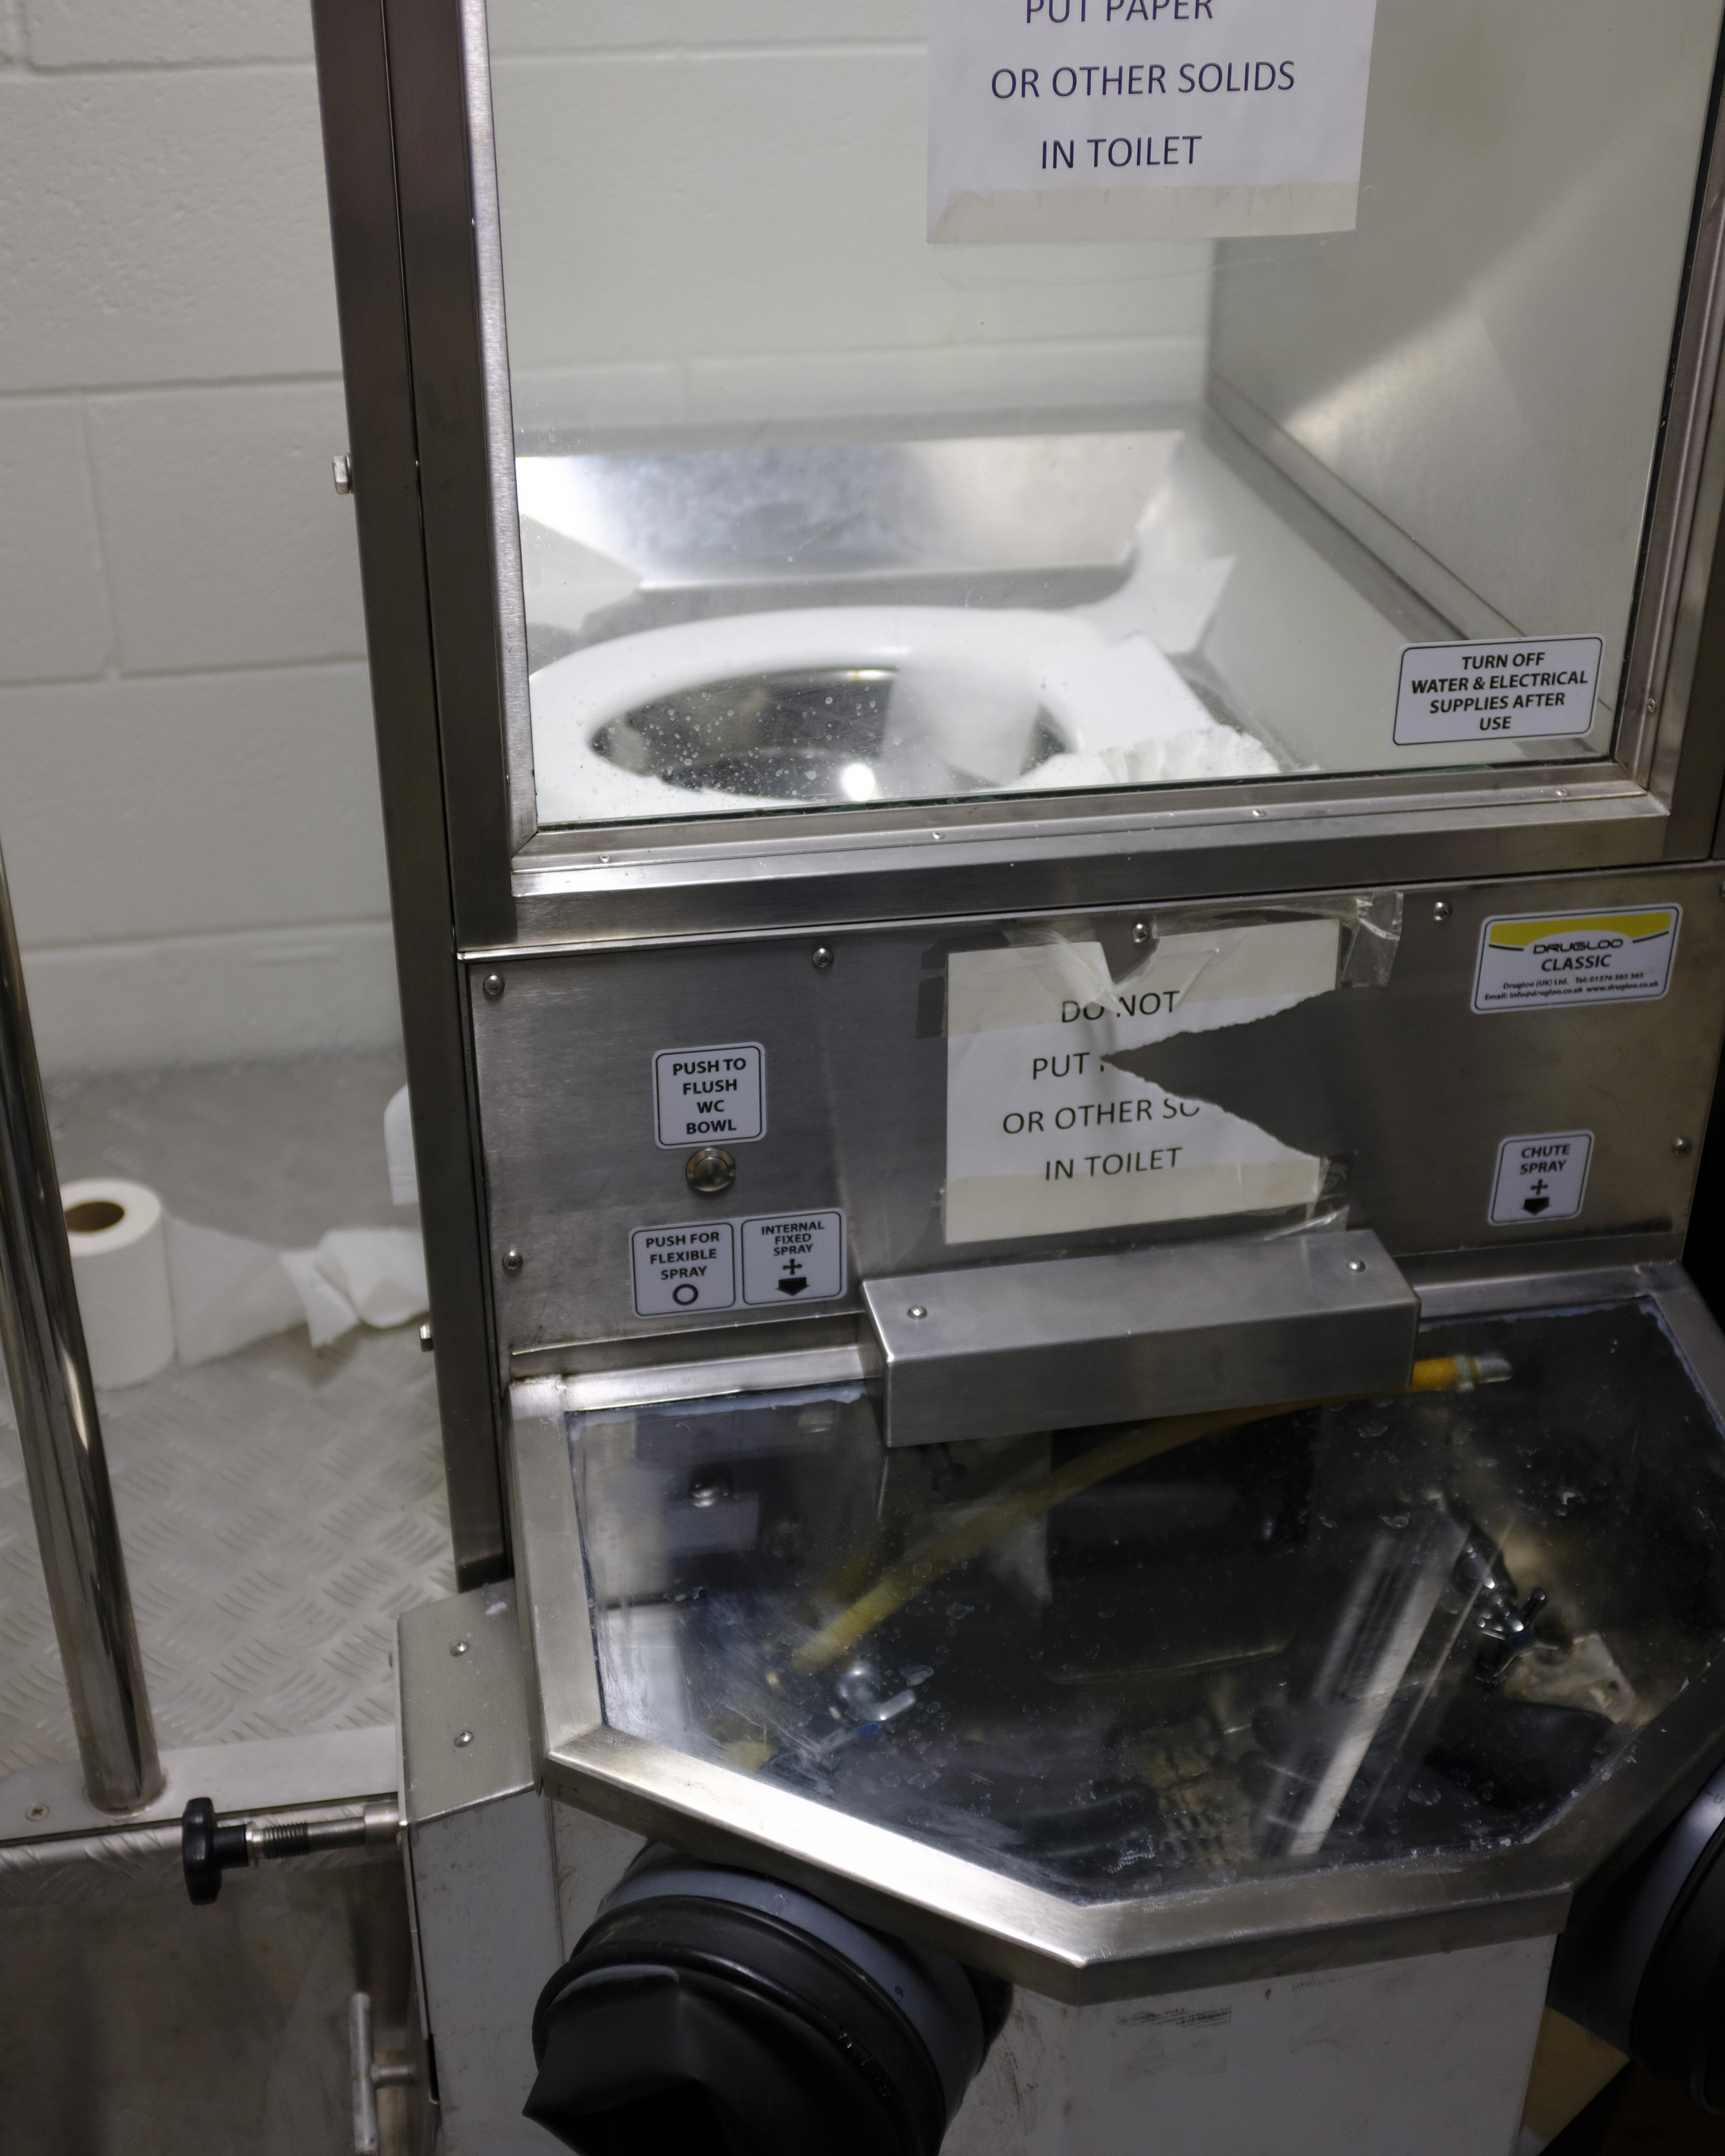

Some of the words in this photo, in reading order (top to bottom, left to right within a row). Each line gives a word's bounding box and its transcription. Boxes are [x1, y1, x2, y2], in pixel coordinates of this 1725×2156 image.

[1026, 0, 1086, 23] PUT
[1106, 0, 1214, 22] PAPER
[991, 68, 1040, 98] OR
[1052, 64, 1167, 97] OTHER
[1177, 60, 1295, 93] SOLIDS
[1041, 139, 1075, 170] IN
[1087, 135, 1202, 167] TOILET
[1462, 654, 1508, 670] TURN
[1512, 652, 1545, 666] OFF
[1412, 678, 1469, 694] WATER
[1473, 676, 1485, 690] &
[1489, 671, 1588, 689] ELECTRICAL
[1430, 696, 1509, 714] SUPPLIES
[1512, 692, 1565, 709] AFTER
[1480, 716, 1512, 731] USE
[1533, 939, 1624, 954] DRUGLOO
[1541, 954, 1611, 972] CLASSIC
[1484, 991, 1508, 1000] Email:
[1509, 986, 1583, 1000] info@drugloo.co.uk
[1586, 980, 1659, 993] www.drugloo.co.uk
[1503, 980, 1535, 990] Drugloo
[1536, 979, 1552, 987] (UK)
[1062, 1000, 1105, 1023] DO
[1116, 990, 1180, 1018] NOT
[672, 1059, 719, 1076] PUSH
[723, 1057, 747, 1071] TO
[1033, 1052, 1090, 1079] PUT
[682, 1079, 737, 1095] FLUSH
[696, 1100, 724, 1113] WC
[1003, 1111, 1044, 1134] OR
[1054, 1099, 1152, 1130] OTHER
[686, 1119, 737, 1135] BOWL
[1521, 1143, 1571, 1159] CHUTE
[1045, 1158, 1074, 1181] IN
[1084, 1147, 1183, 1177] TOILET
[1519, 1159, 1567, 1175] SPRAY
[761, 1220, 825, 1235] INTERNAL
[645, 1235, 686, 1249] PUSH
[690, 1231, 720, 1245] FOR
[775, 1233, 811, 1245] FIXED
[650, 1248, 717, 1265] FLEXIBLE
[773, 1244, 813, 1257] SPRAY
[661, 1266, 707, 1280] SPRAY
